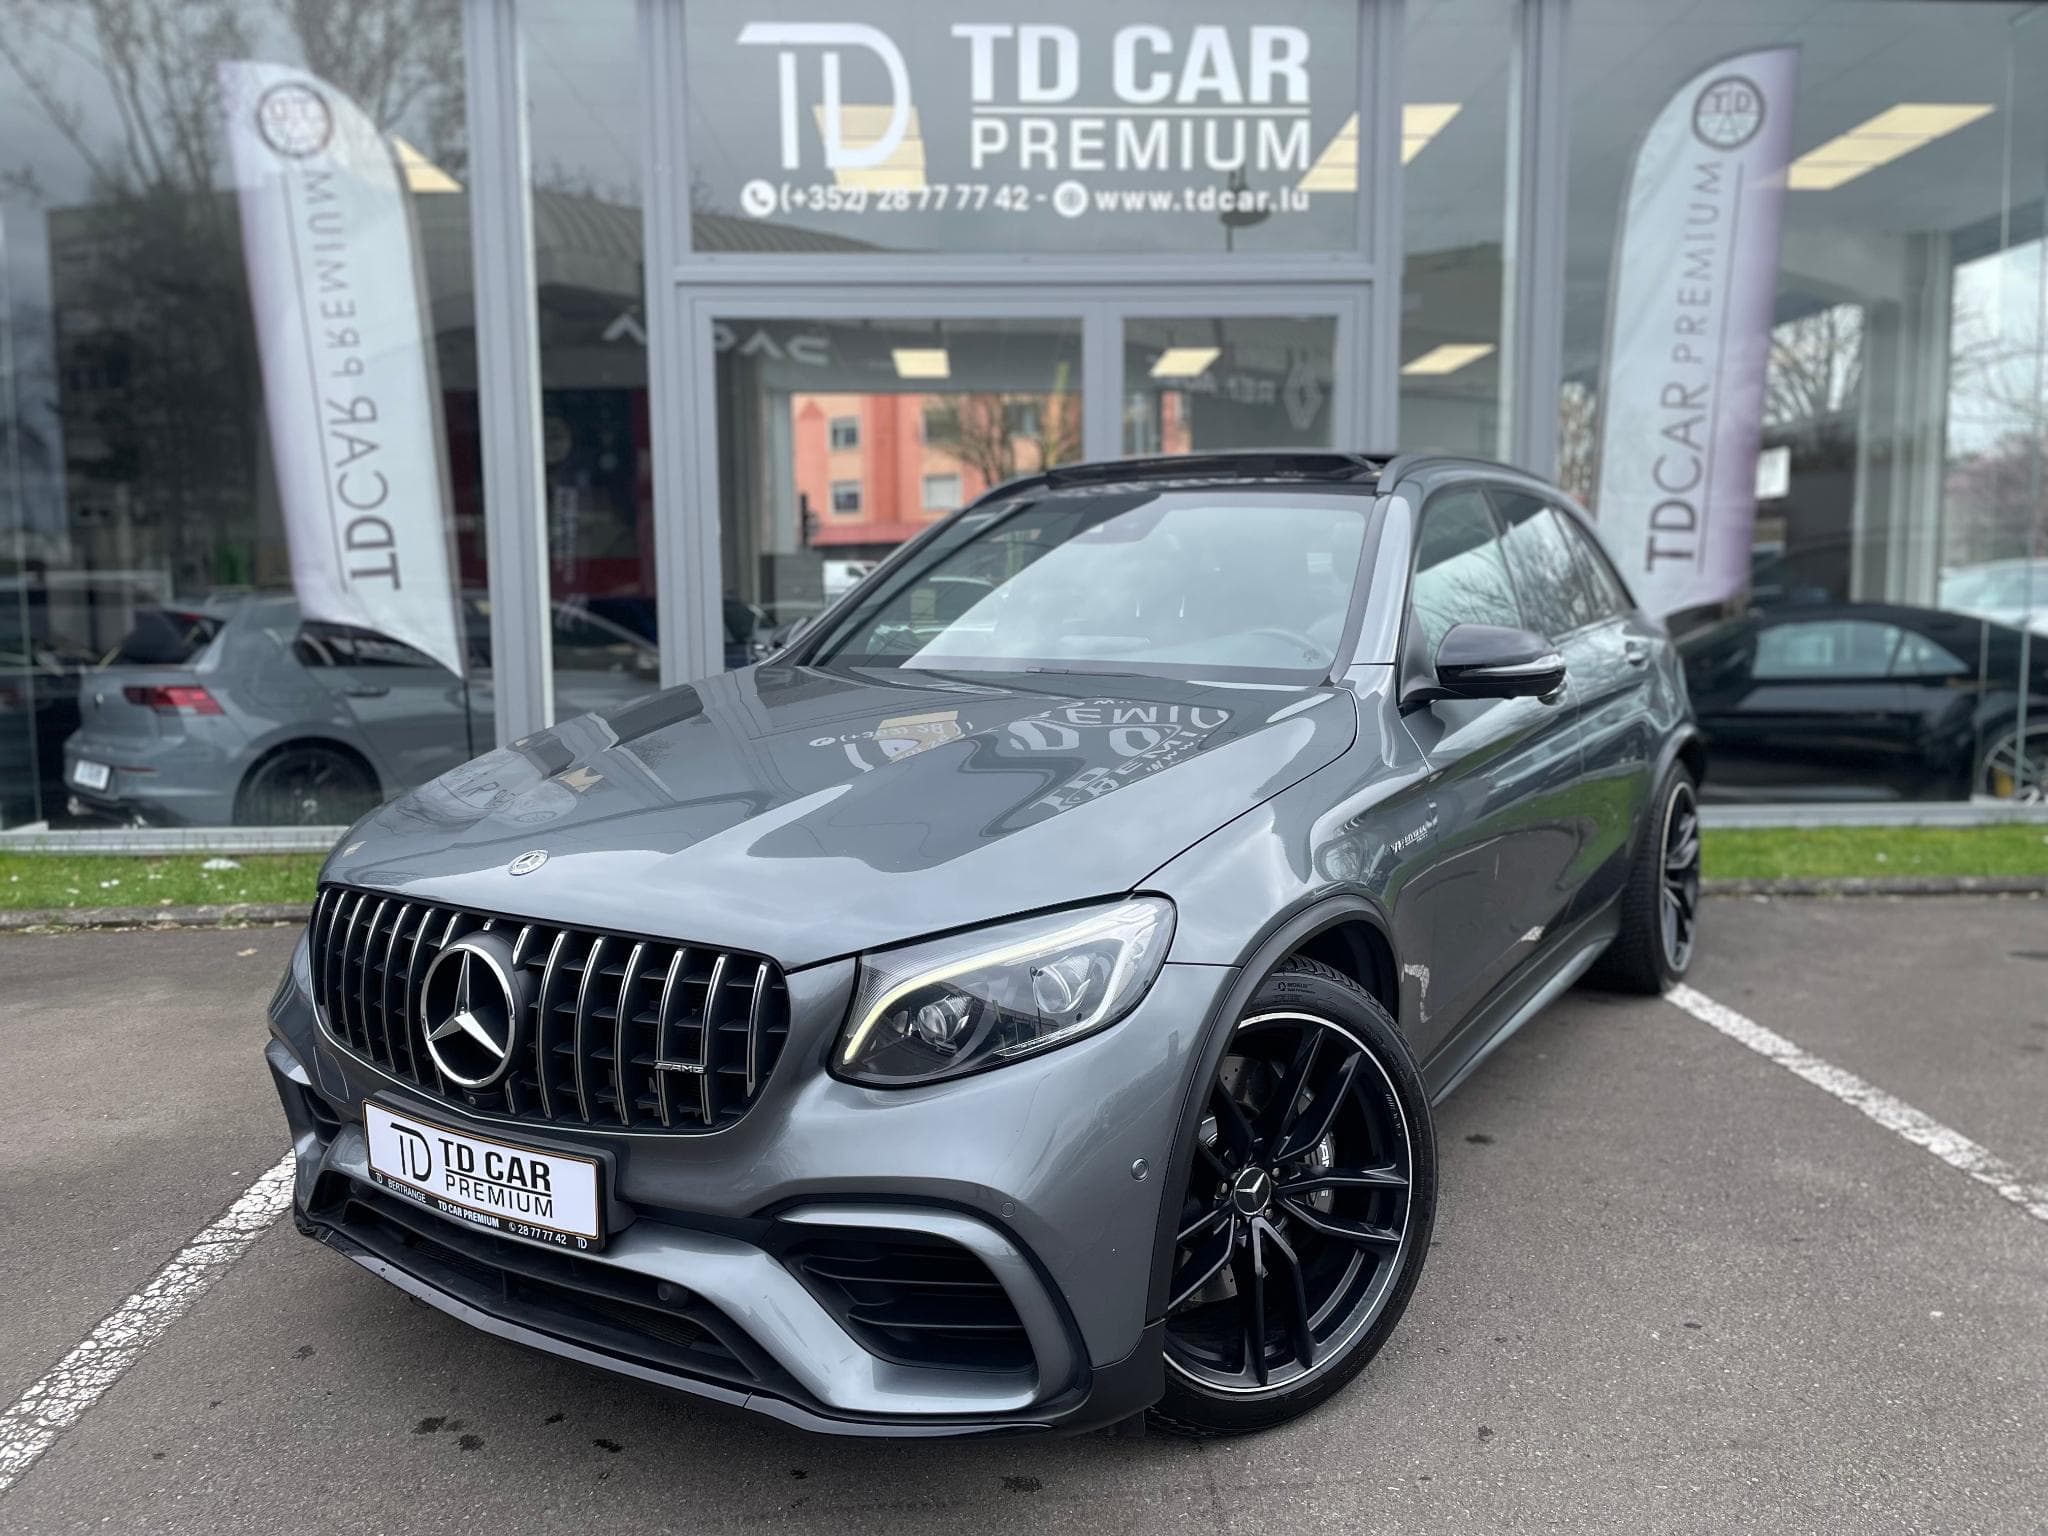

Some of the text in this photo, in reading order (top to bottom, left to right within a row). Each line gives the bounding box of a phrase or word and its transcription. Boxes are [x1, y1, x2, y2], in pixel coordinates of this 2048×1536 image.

[951, 23, 1311, 105] TD CAR
[970, 118, 1311, 171] PREMIUM
[874, 184, 911, 212] 28
[916, 184, 949, 211] 77
[955, 184, 990, 211] 77
[993, 184, 1029, 212] 42
[1094, 185, 1310, 213] www.tdcar.lu
[1645, 160, 1724, 574] TDCAR PREMIUM
[438, 1138, 551, 1192] TD CAR
[387, 1178, 427, 1204] BERTRANGE
[437, 1200, 448, 1211] TD
[448, 1205, 463, 1217] CAR
[463, 1210, 500, 1228] PREMIUM
[518, 1224, 529, 1236] 28
[530, 1228, 541, 1239] 77
[542, 1231, 553, 1241] 77
[555, 1233, 567, 1245] 42
[445, 1173, 553, 1219] PREMIUM
